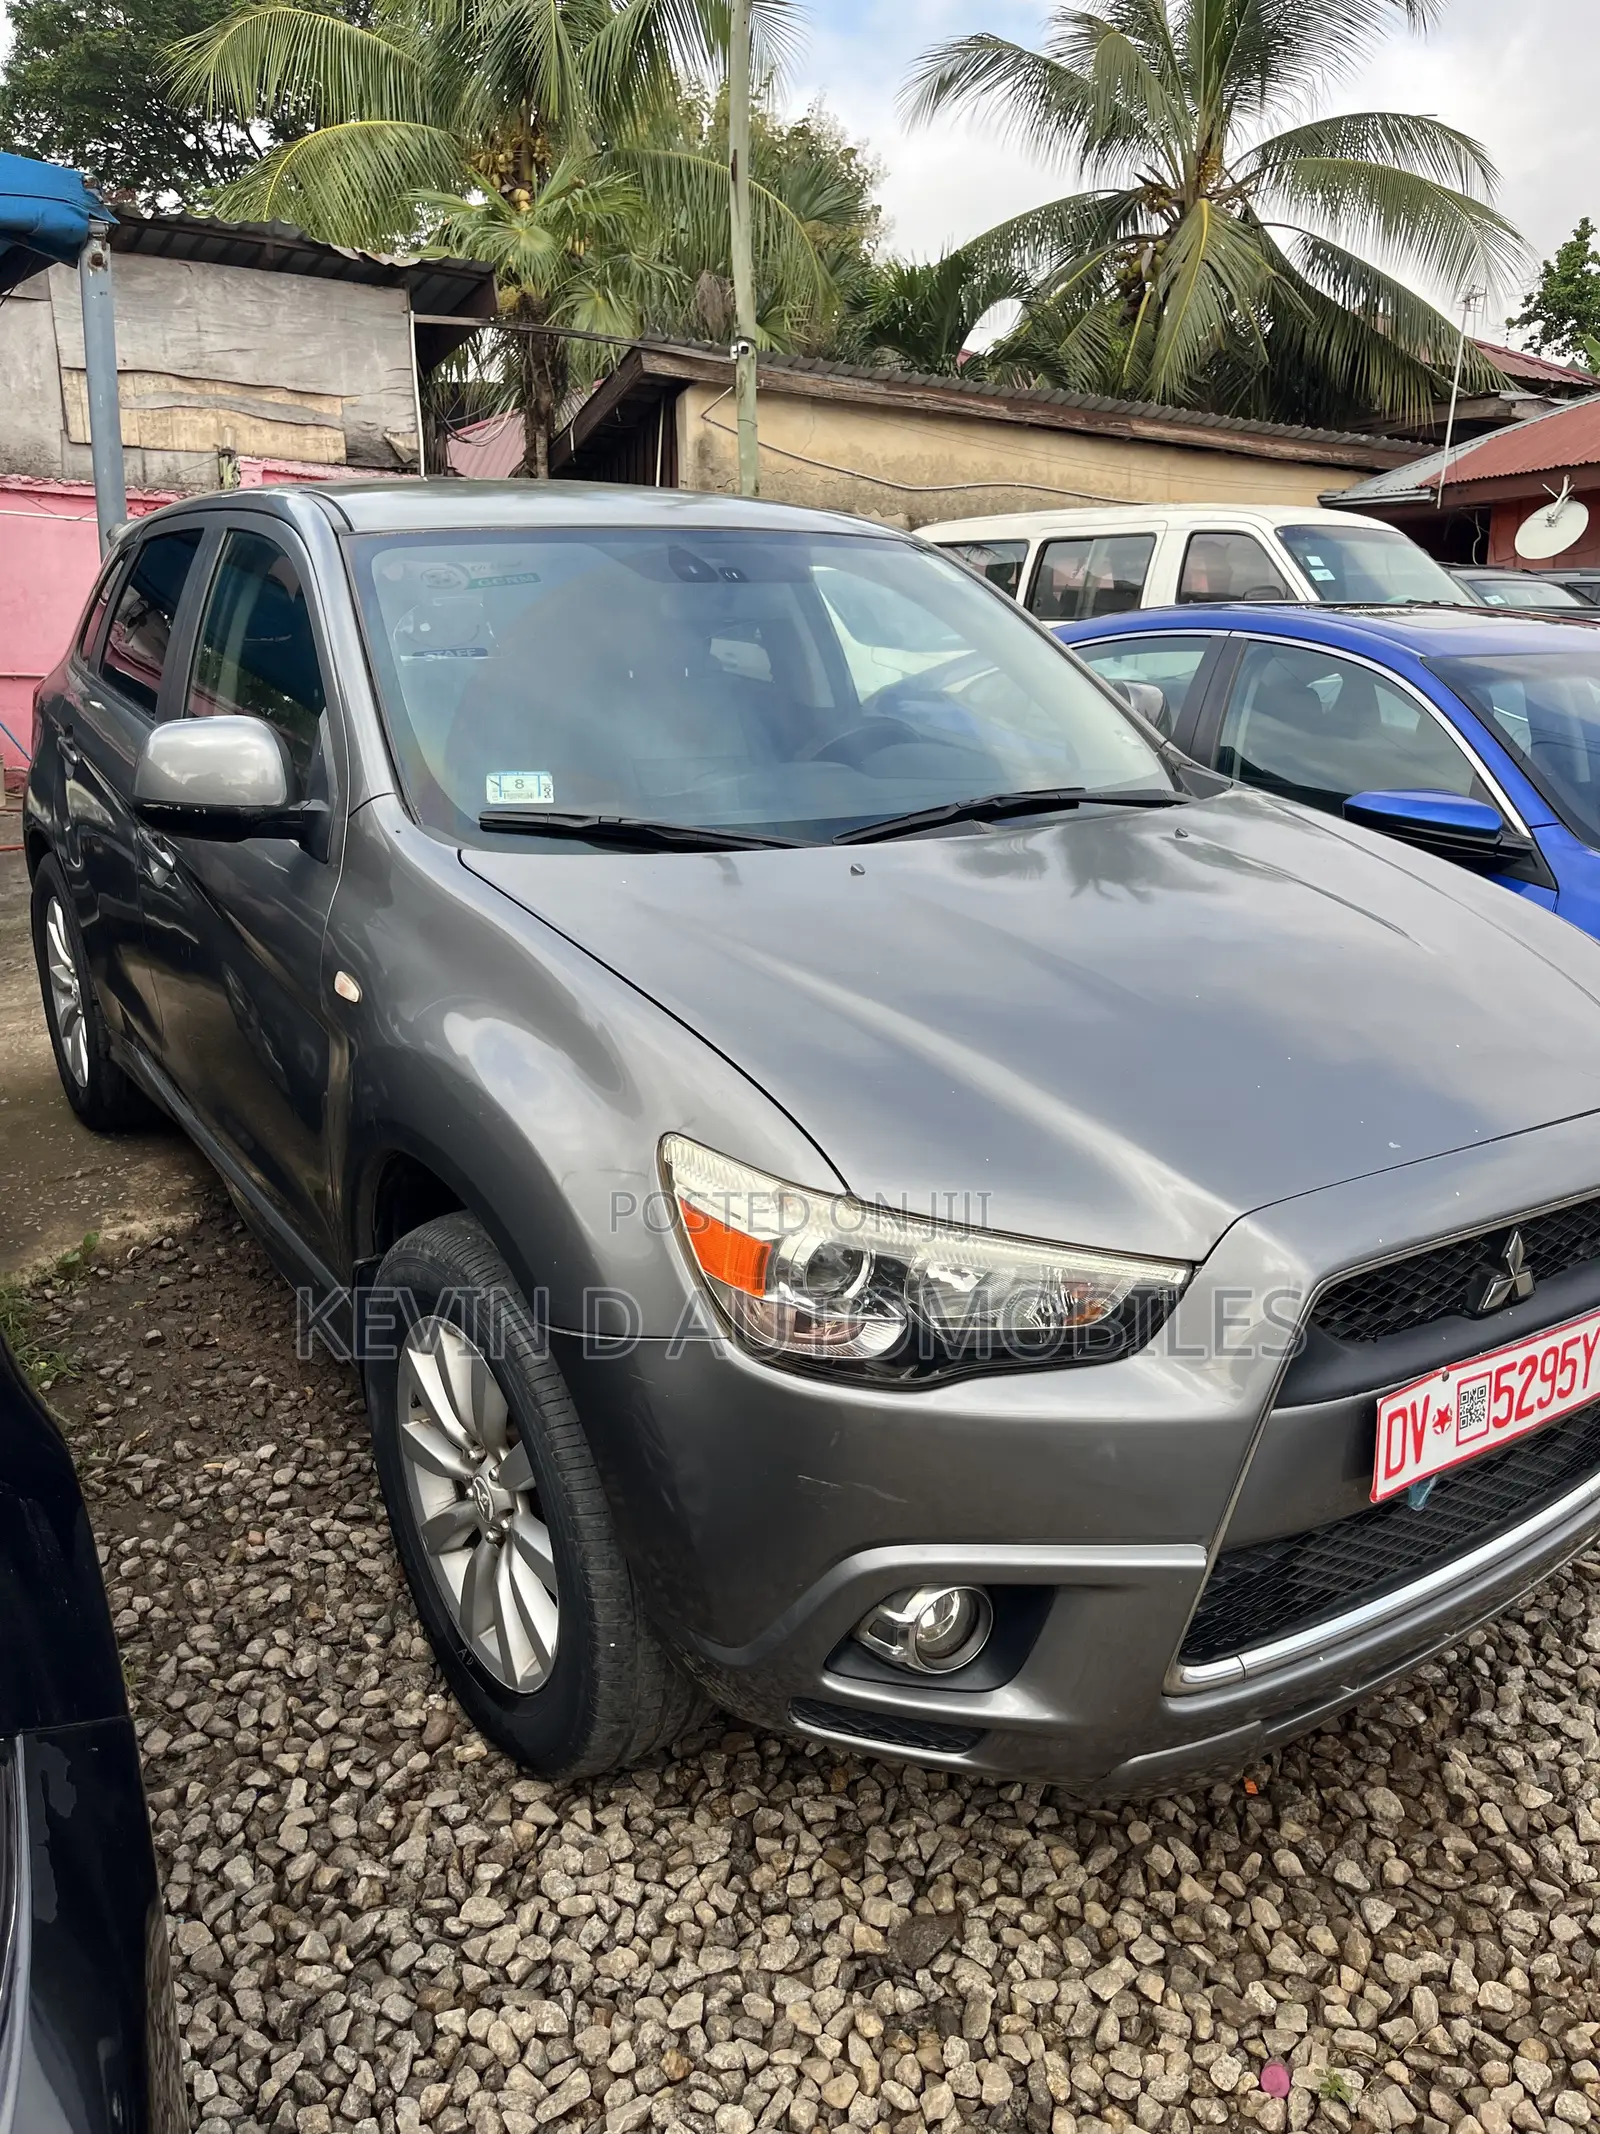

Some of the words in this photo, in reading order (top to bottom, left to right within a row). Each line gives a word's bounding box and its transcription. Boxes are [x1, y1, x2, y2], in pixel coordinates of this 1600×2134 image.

[514, 778, 525, 790] 8
[1384, 1394, 1430, 1480] DV
[1493, 1325, 1600, 1428] 5295Y
